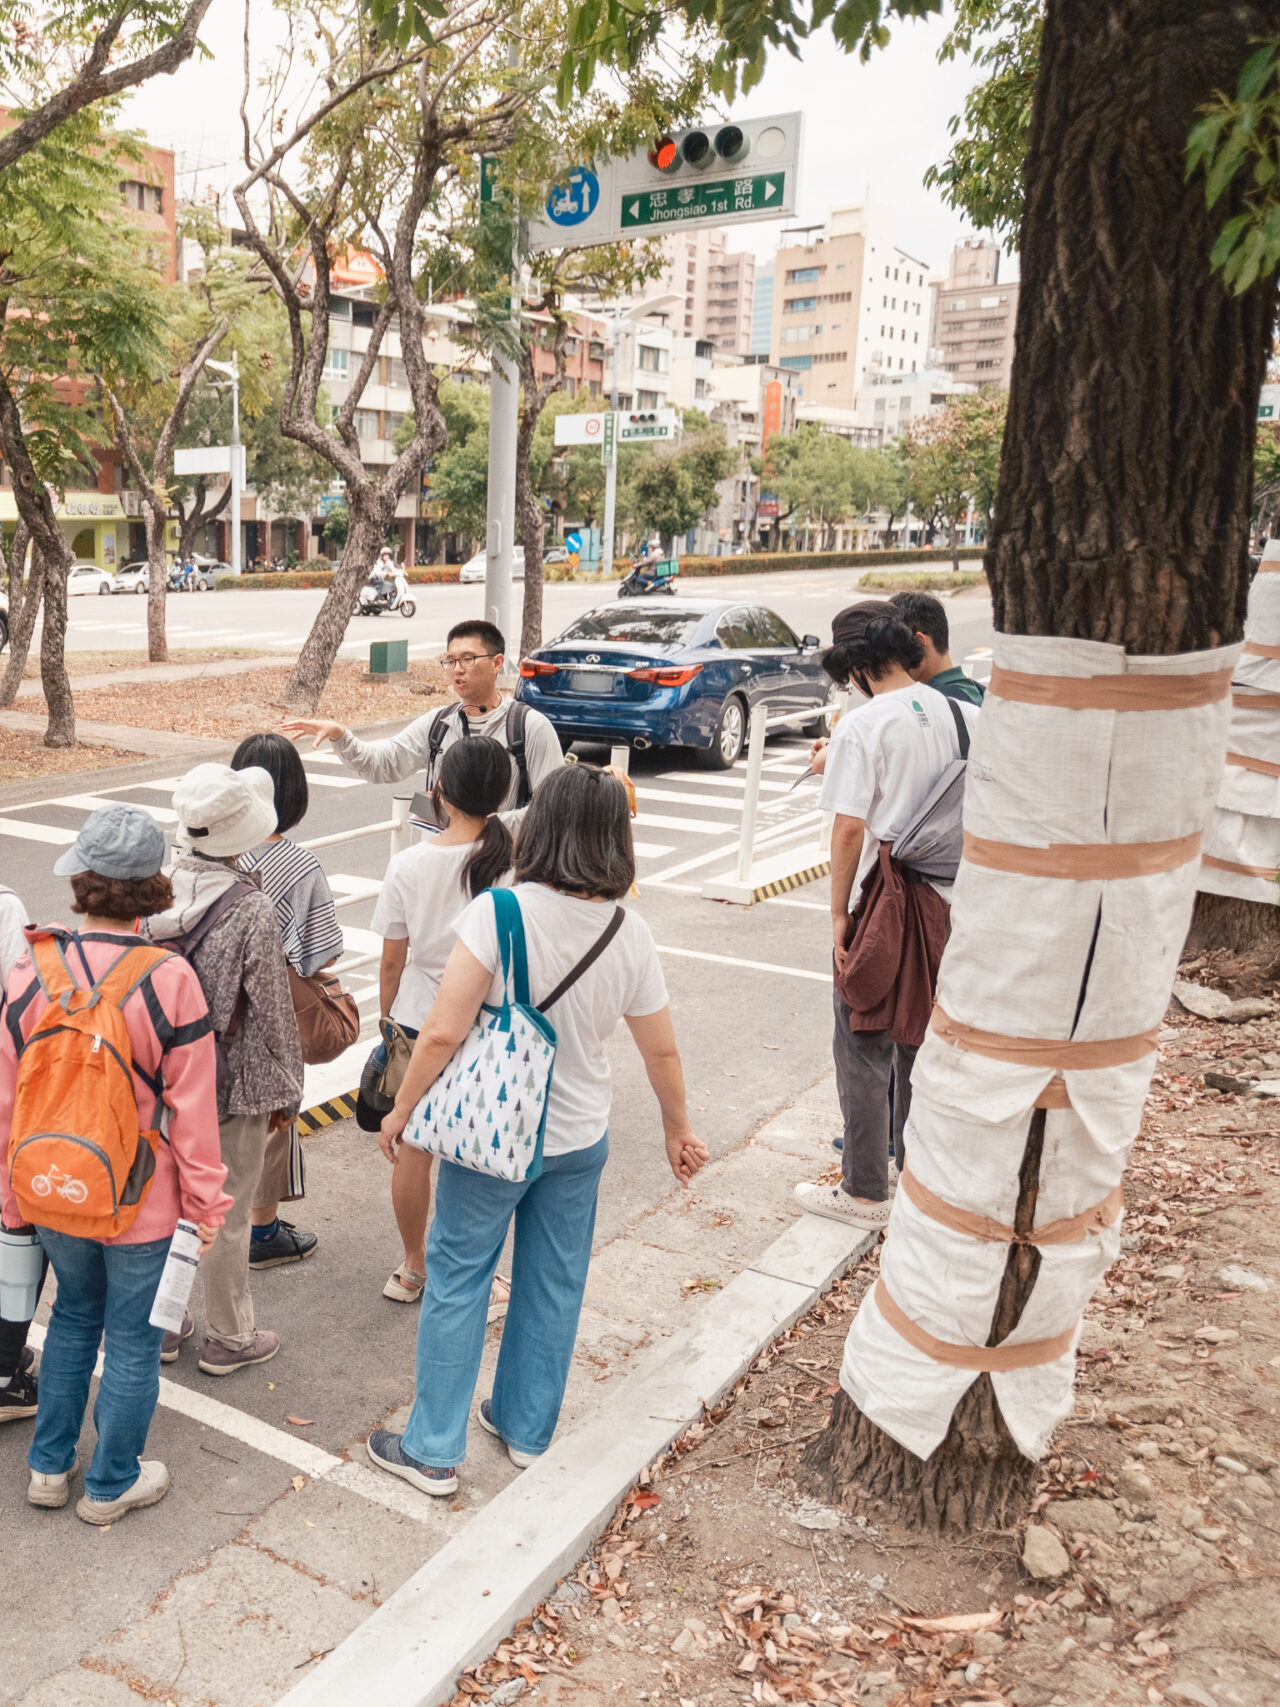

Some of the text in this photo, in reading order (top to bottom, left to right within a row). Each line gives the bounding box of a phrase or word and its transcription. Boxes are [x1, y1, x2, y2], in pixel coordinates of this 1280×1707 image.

[649, 179, 754, 208] 忠孝一路
[650, 196, 755, 221] Jhongsiao 1st Rd.
